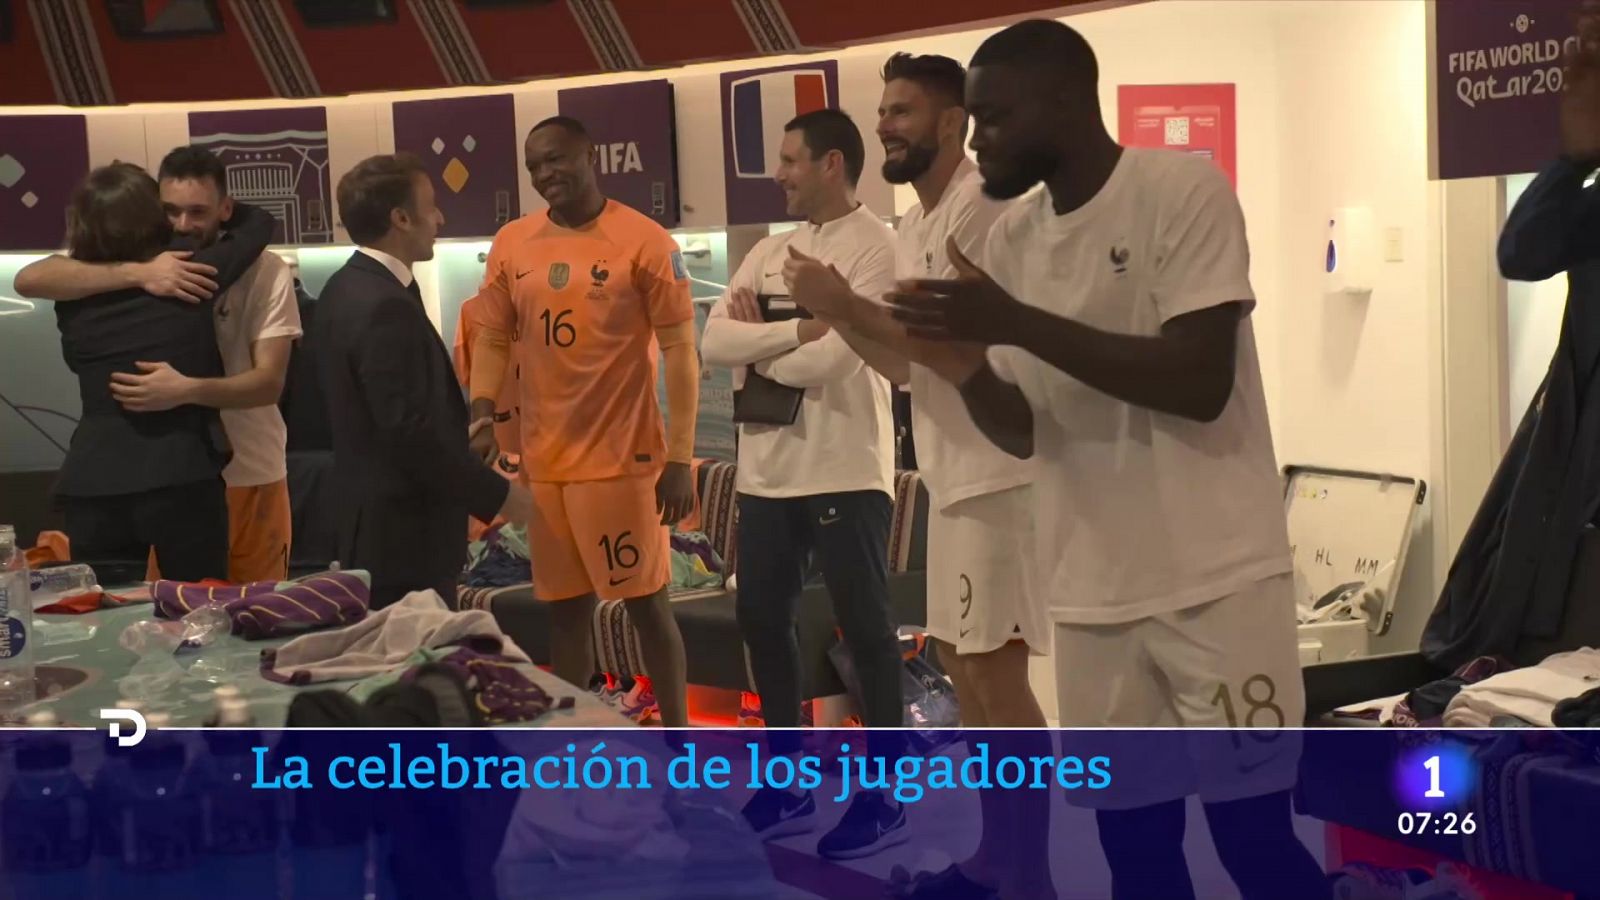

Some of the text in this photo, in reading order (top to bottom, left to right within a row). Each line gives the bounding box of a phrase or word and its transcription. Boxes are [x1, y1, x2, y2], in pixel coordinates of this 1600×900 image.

[1449, 50, 1488, 74] FIFA
[1490, 39, 1560, 69] WORLD
[592, 141, 644, 175] IFA
[539, 308, 577, 348] 16
[598, 530, 640, 571] 16
[959, 573, 972, 619] 9
[1211, 673, 1285, 750] 18
